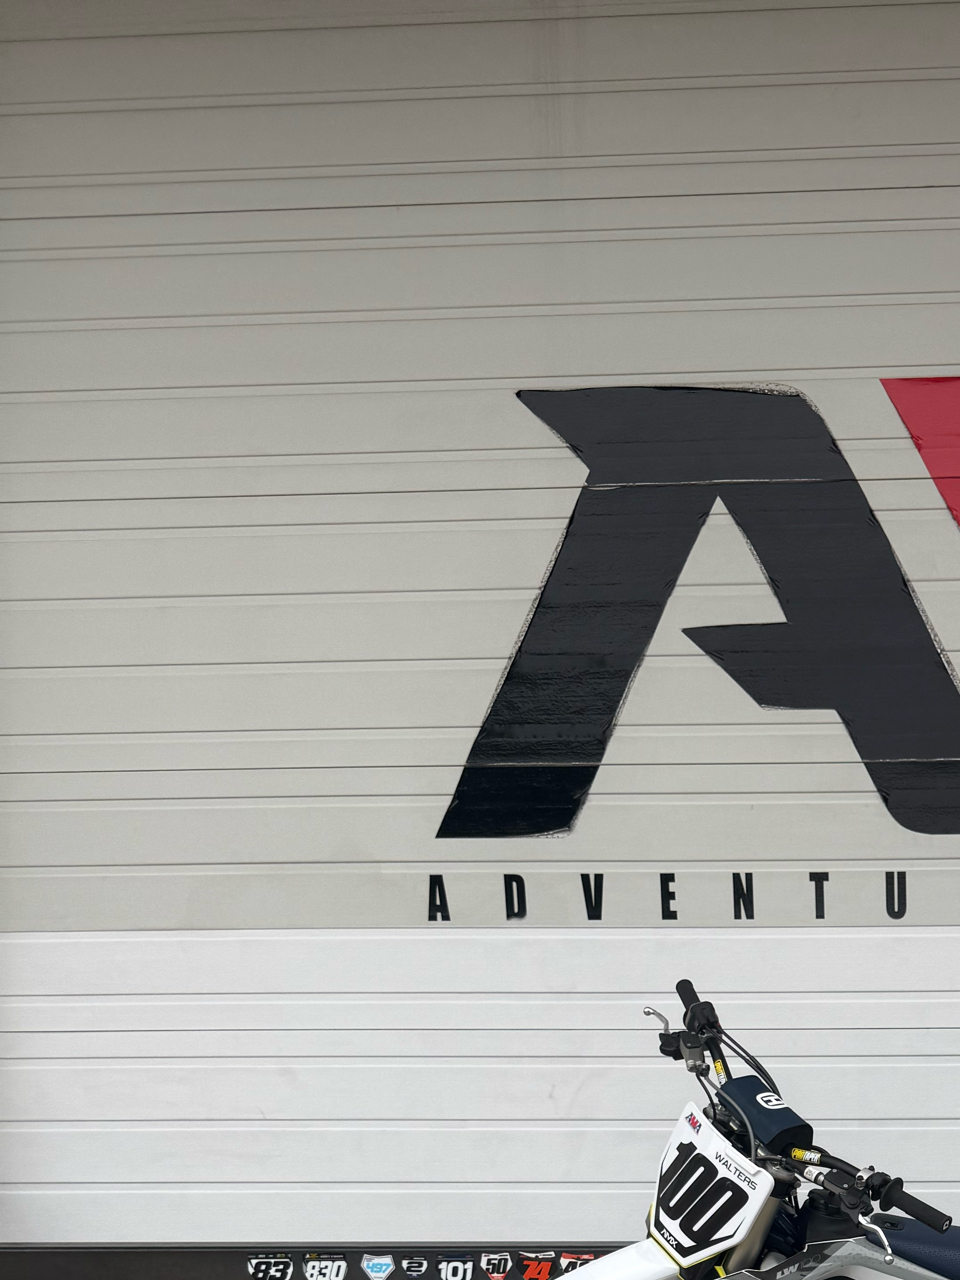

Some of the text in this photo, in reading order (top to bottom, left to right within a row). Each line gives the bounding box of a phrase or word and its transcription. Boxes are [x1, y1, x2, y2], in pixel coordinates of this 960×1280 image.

[715, 1151, 758, 1191] WALTERS
[660, 1141, 749, 1243] 100
[366, 1262, 392, 1274] 497
[406, 1261, 424, 1273] 2
[485, 1258, 508, 1275] 50
